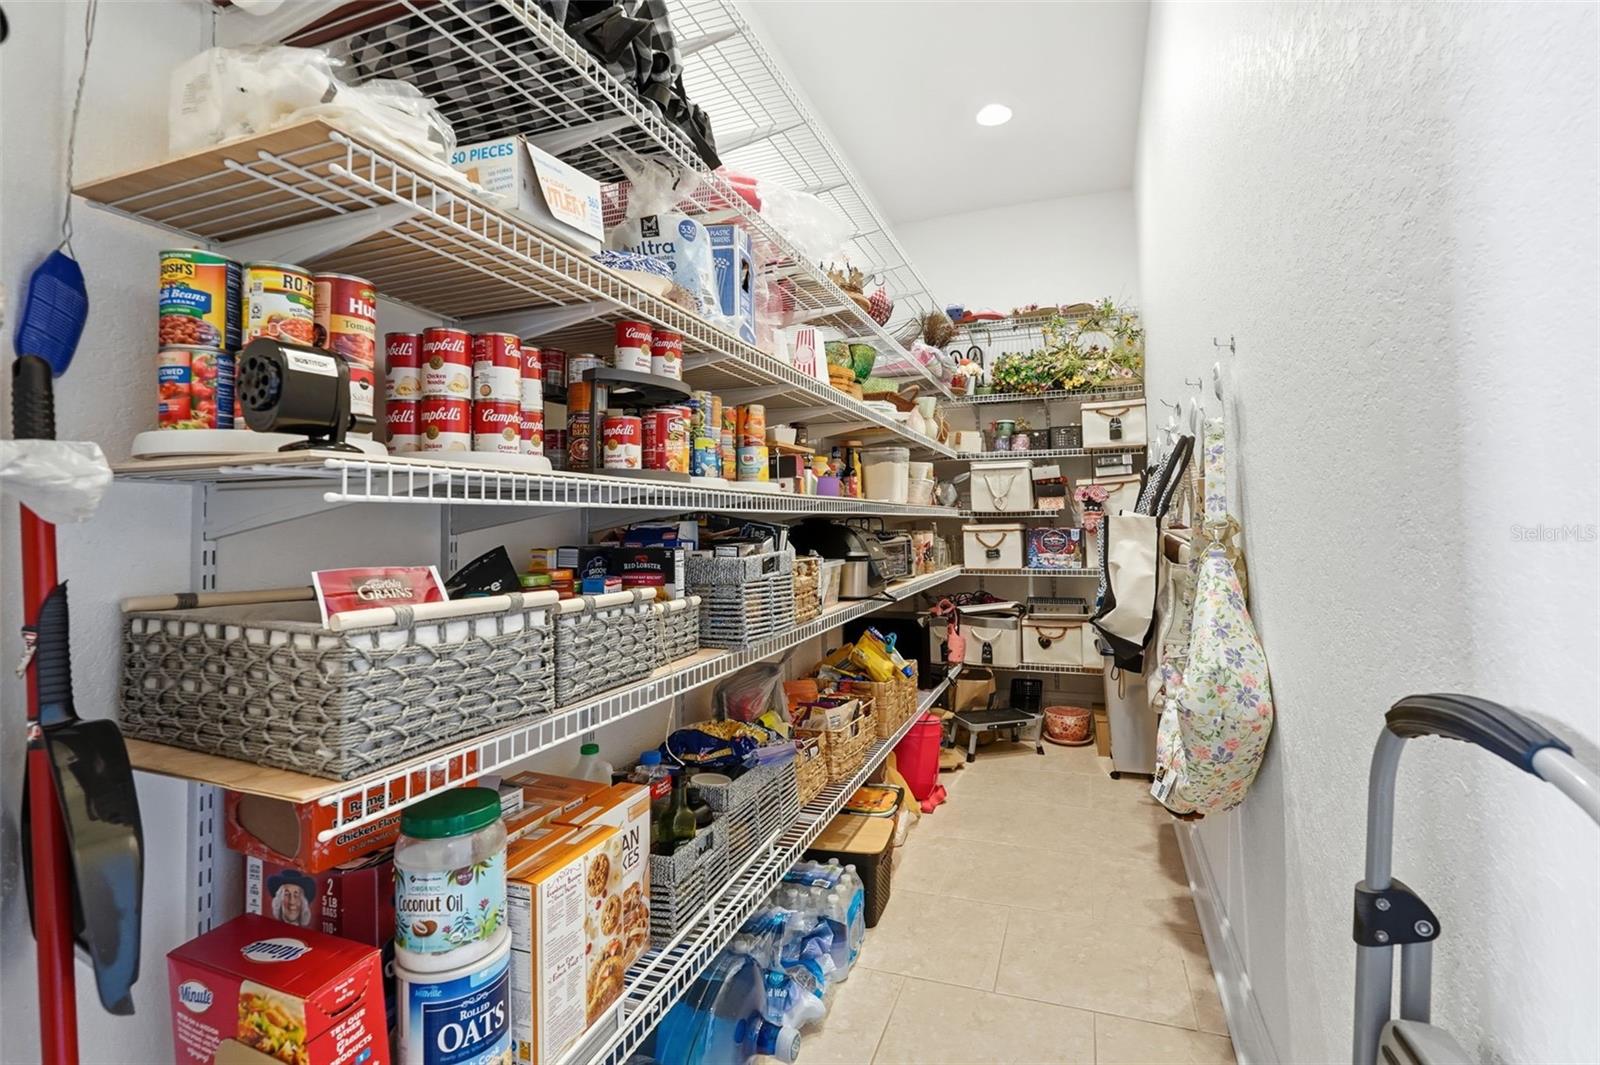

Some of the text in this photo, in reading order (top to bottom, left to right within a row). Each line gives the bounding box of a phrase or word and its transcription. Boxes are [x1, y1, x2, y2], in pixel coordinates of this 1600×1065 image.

[469, 142, 513, 161] PIECES
[171, 288, 207, 302] Beans
[294, 356, 329, 368] BOSTITCH
[623, 561, 662, 570] RED LOBSTER
[337, 824, 377, 846] Chicken
[327, 878, 334, 896] 2
[411, 885, 441, 893] ORGANIC
[322, 895, 338, 909] 5 LB
[398, 893, 464, 913] Coconut Oil
[322, 906, 338, 918] BAGS
[181, 986, 213, 1005] Minute
[460, 1001, 491, 1022] ROLLED
[330, 1008, 366, 1038] TRY OUR
[437, 999, 505, 1054] OATS
[330, 1033, 373, 1065] RODUCTS
